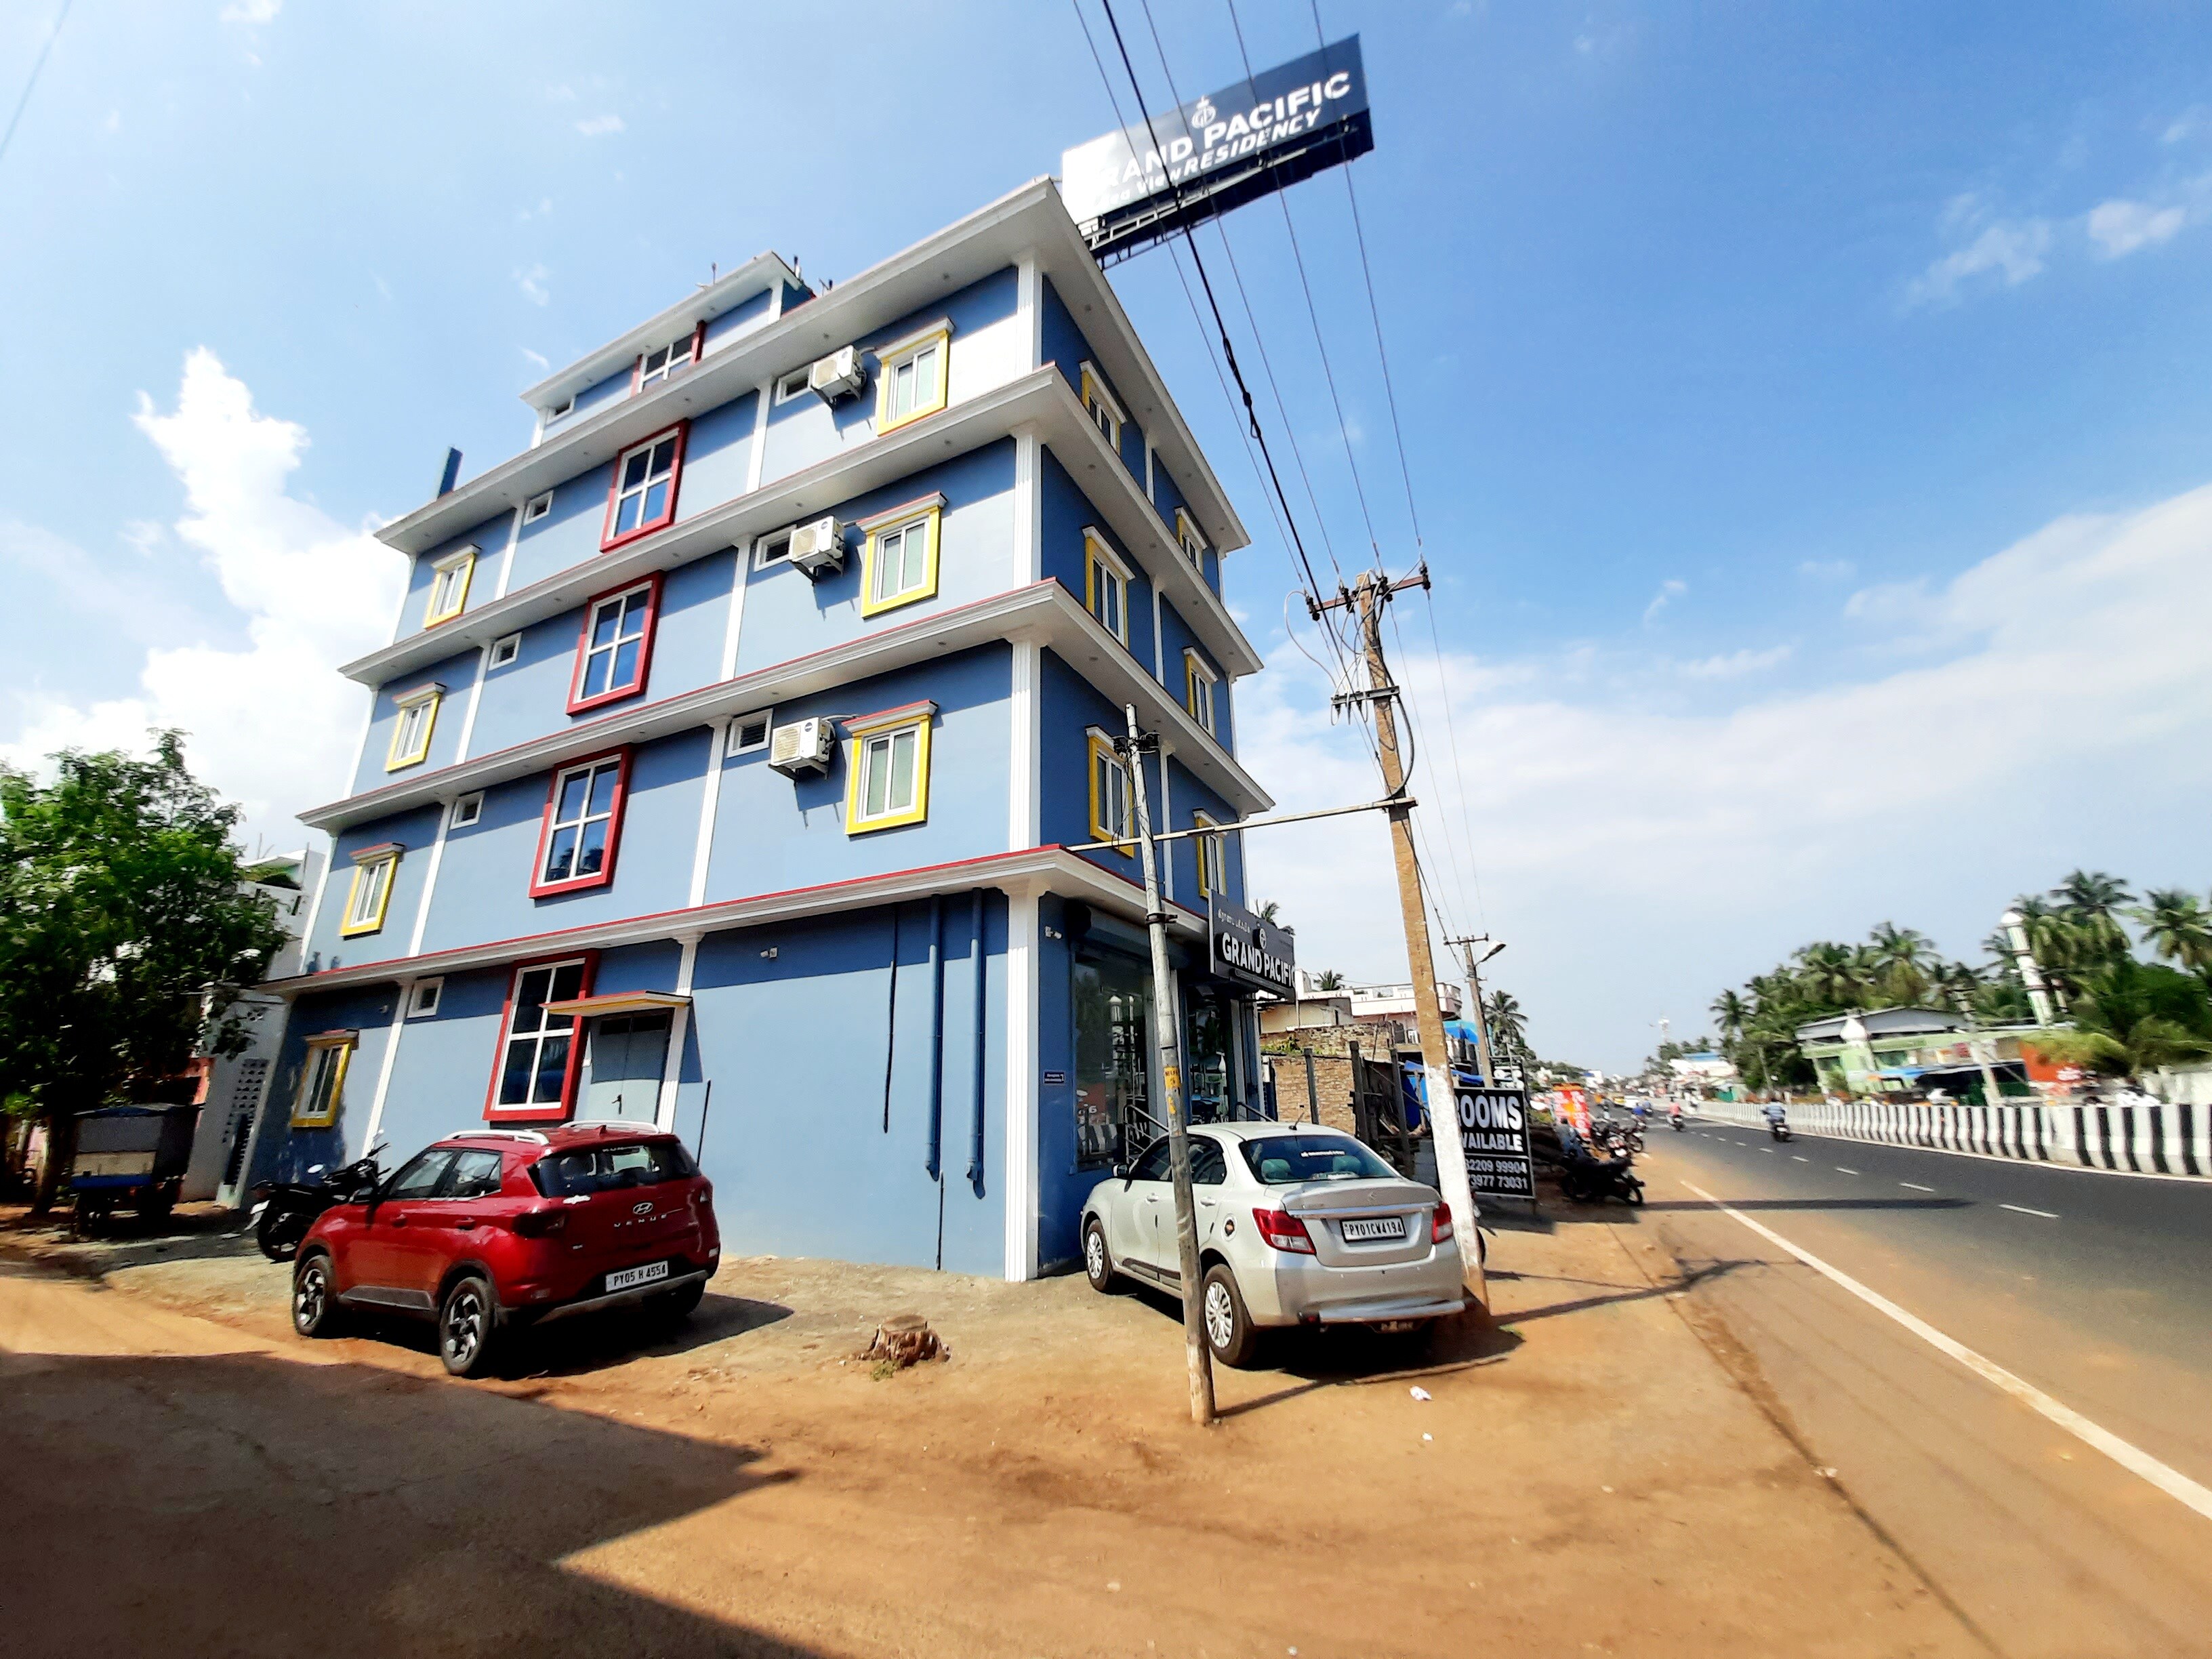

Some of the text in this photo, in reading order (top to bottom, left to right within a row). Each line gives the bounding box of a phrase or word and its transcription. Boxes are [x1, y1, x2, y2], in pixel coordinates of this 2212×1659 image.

[1098, 71, 1351, 187] RAND PACIFIC
[1183, 107, 1322, 177] RESIDENCY
[1222, 932, 1262, 974] GRAND
[1461, 1132, 1524, 1152] VAILABLE
[1468, 1174, 1494, 1188] 3977
[614, 1271, 635, 1286] PY05
[638, 1269, 644, 1279] H
